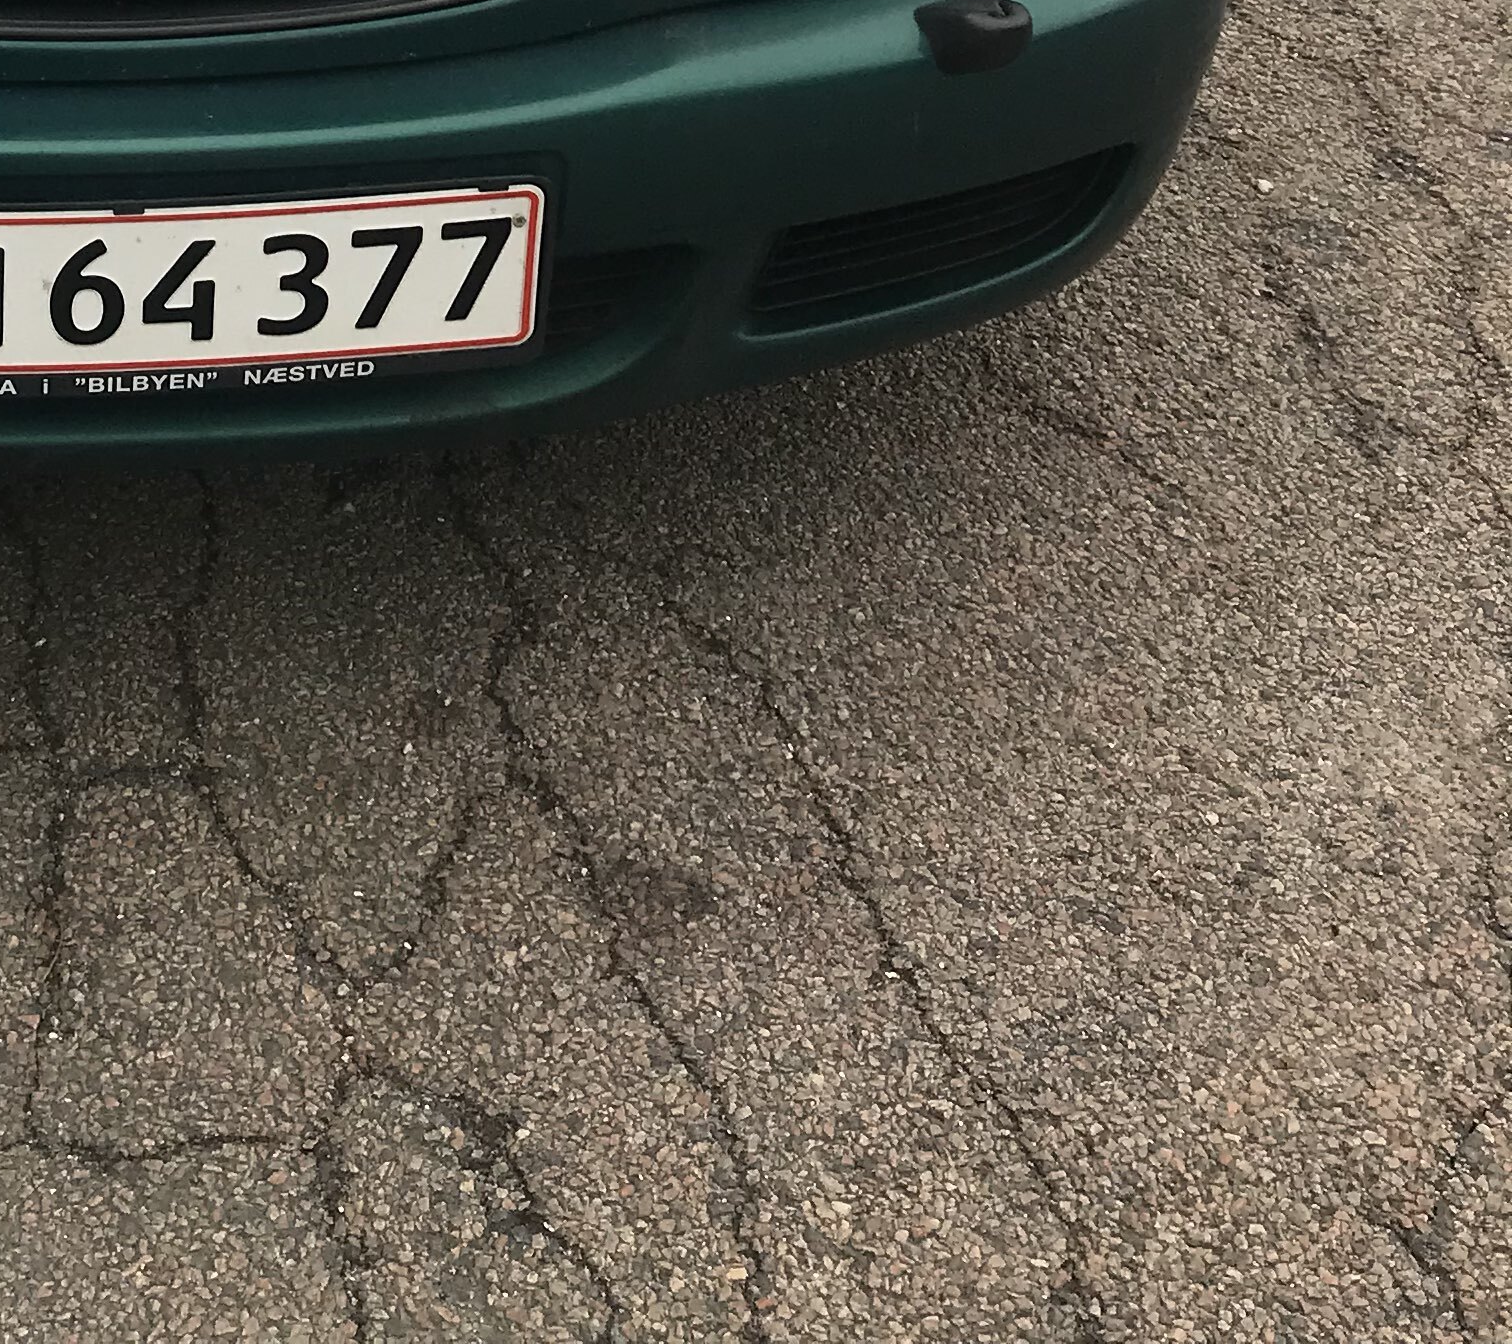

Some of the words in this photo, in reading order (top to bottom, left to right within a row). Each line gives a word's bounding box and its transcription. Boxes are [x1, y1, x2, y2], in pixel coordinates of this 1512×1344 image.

[49, 238, 217, 346] 64
[256, 216, 514, 336] 377
[42, 379, 49, 395] i
[244, 360, 375, 386] NÆSTVED
